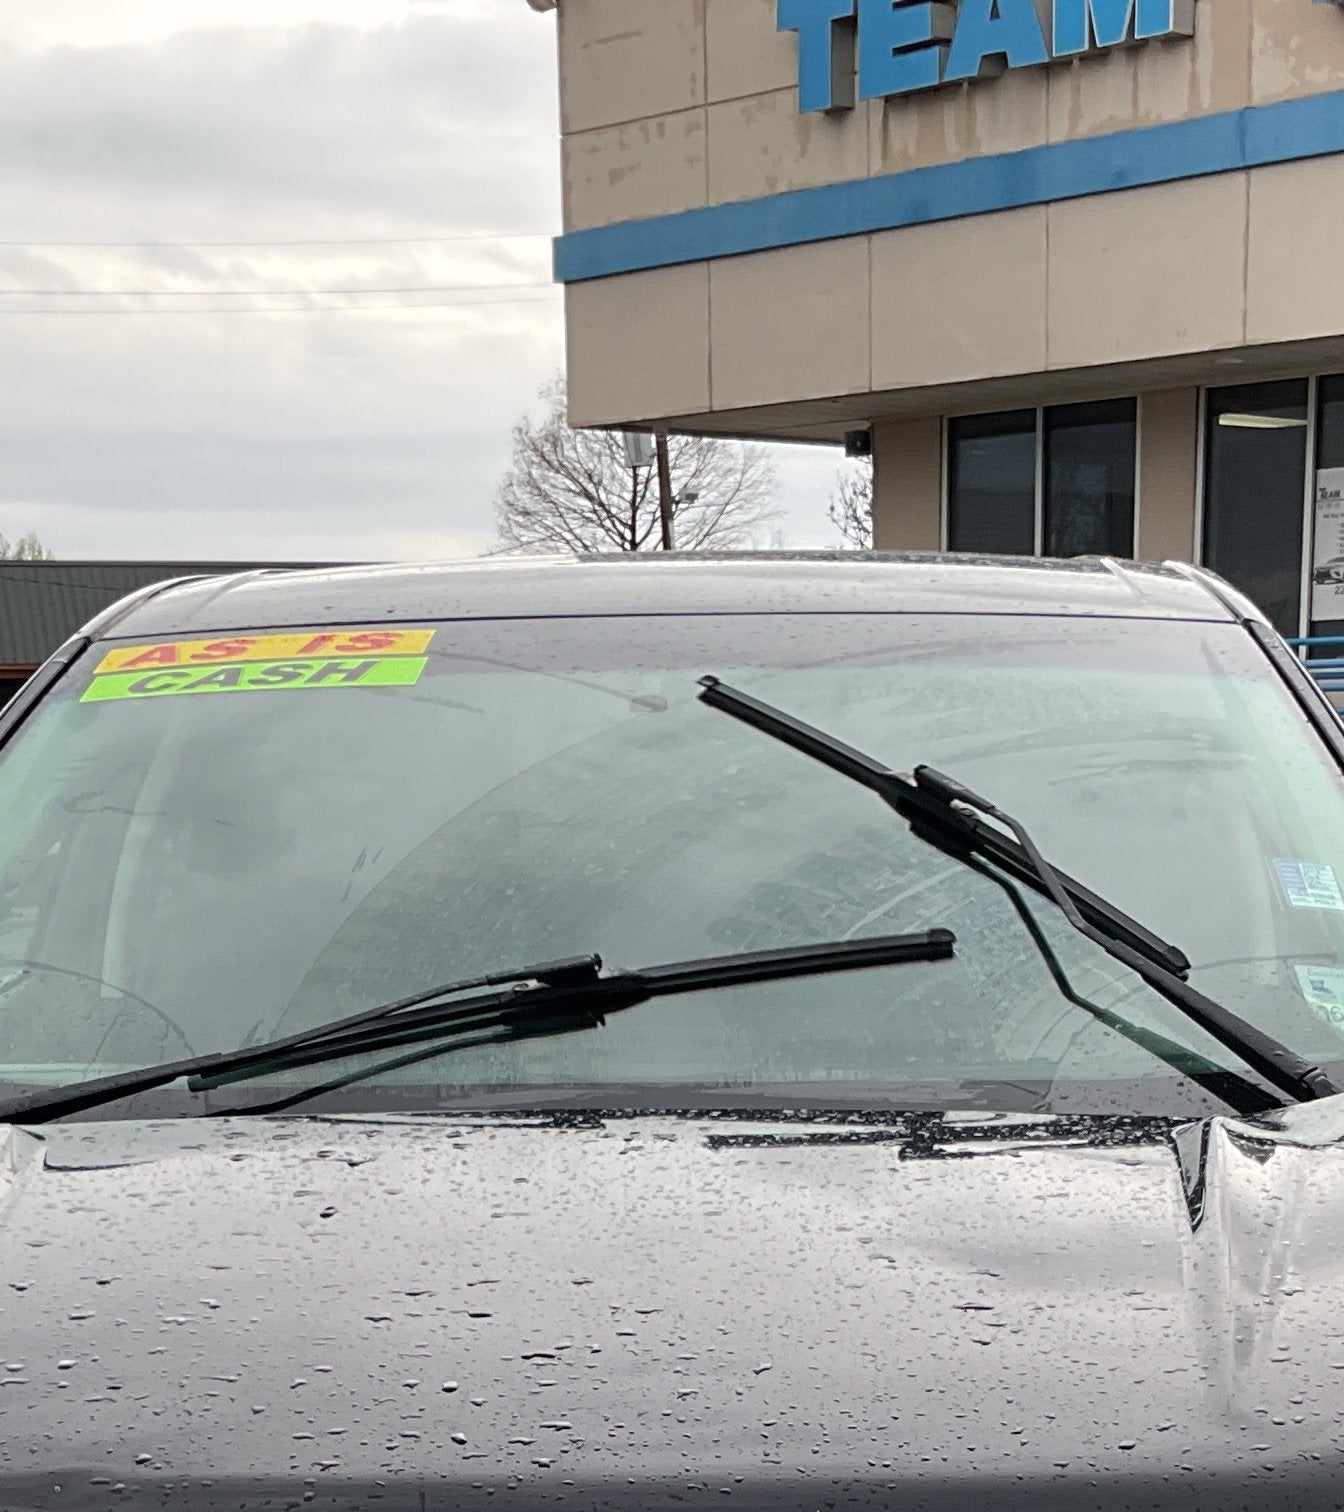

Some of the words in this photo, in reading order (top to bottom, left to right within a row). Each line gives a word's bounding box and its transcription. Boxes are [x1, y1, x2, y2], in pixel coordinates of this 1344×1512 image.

[120, 638, 257, 668] AS
[295, 632, 404, 655] IS
[127, 660, 381, 695] CASH
